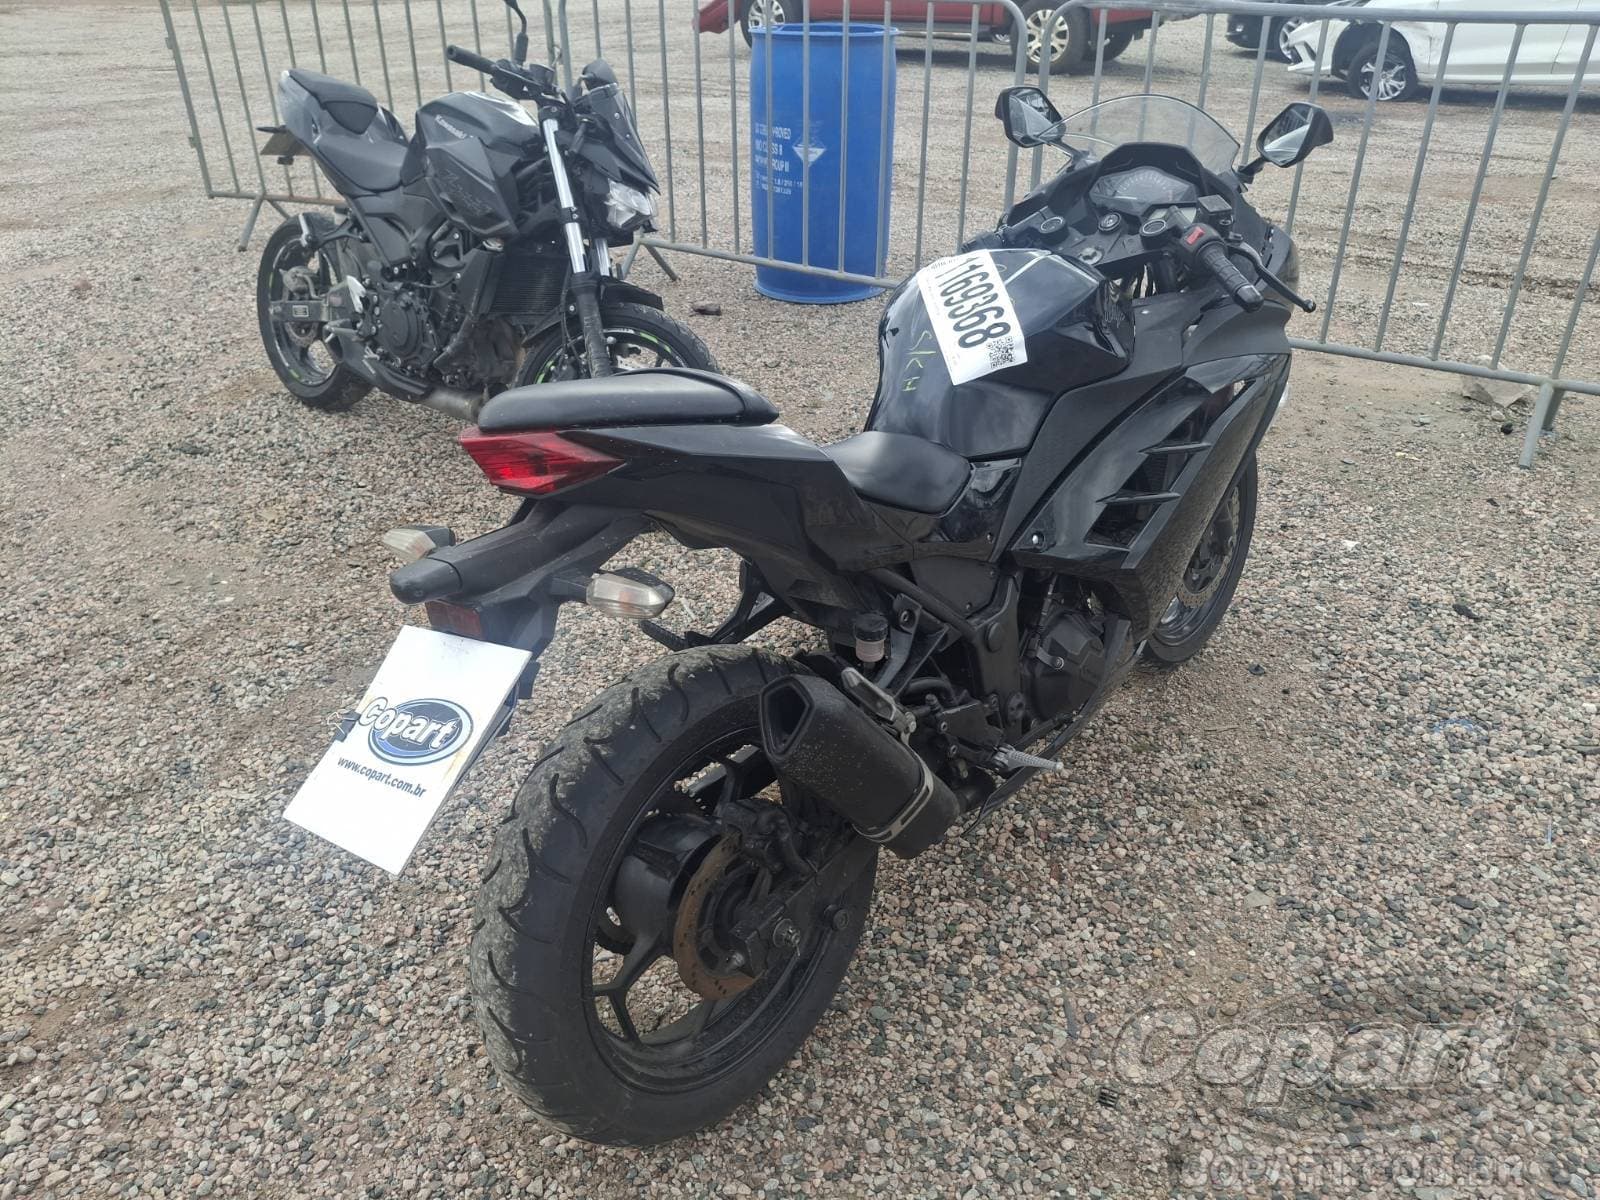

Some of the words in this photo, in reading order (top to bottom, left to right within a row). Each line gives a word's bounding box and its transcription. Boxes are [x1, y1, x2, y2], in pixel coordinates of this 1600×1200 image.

[435, 114, 467, 140] Kawasaki
[934, 256, 1012, 349] 1169368
[357, 696, 461, 751] Copart
[337, 755, 427, 798] www.copart.com.br
